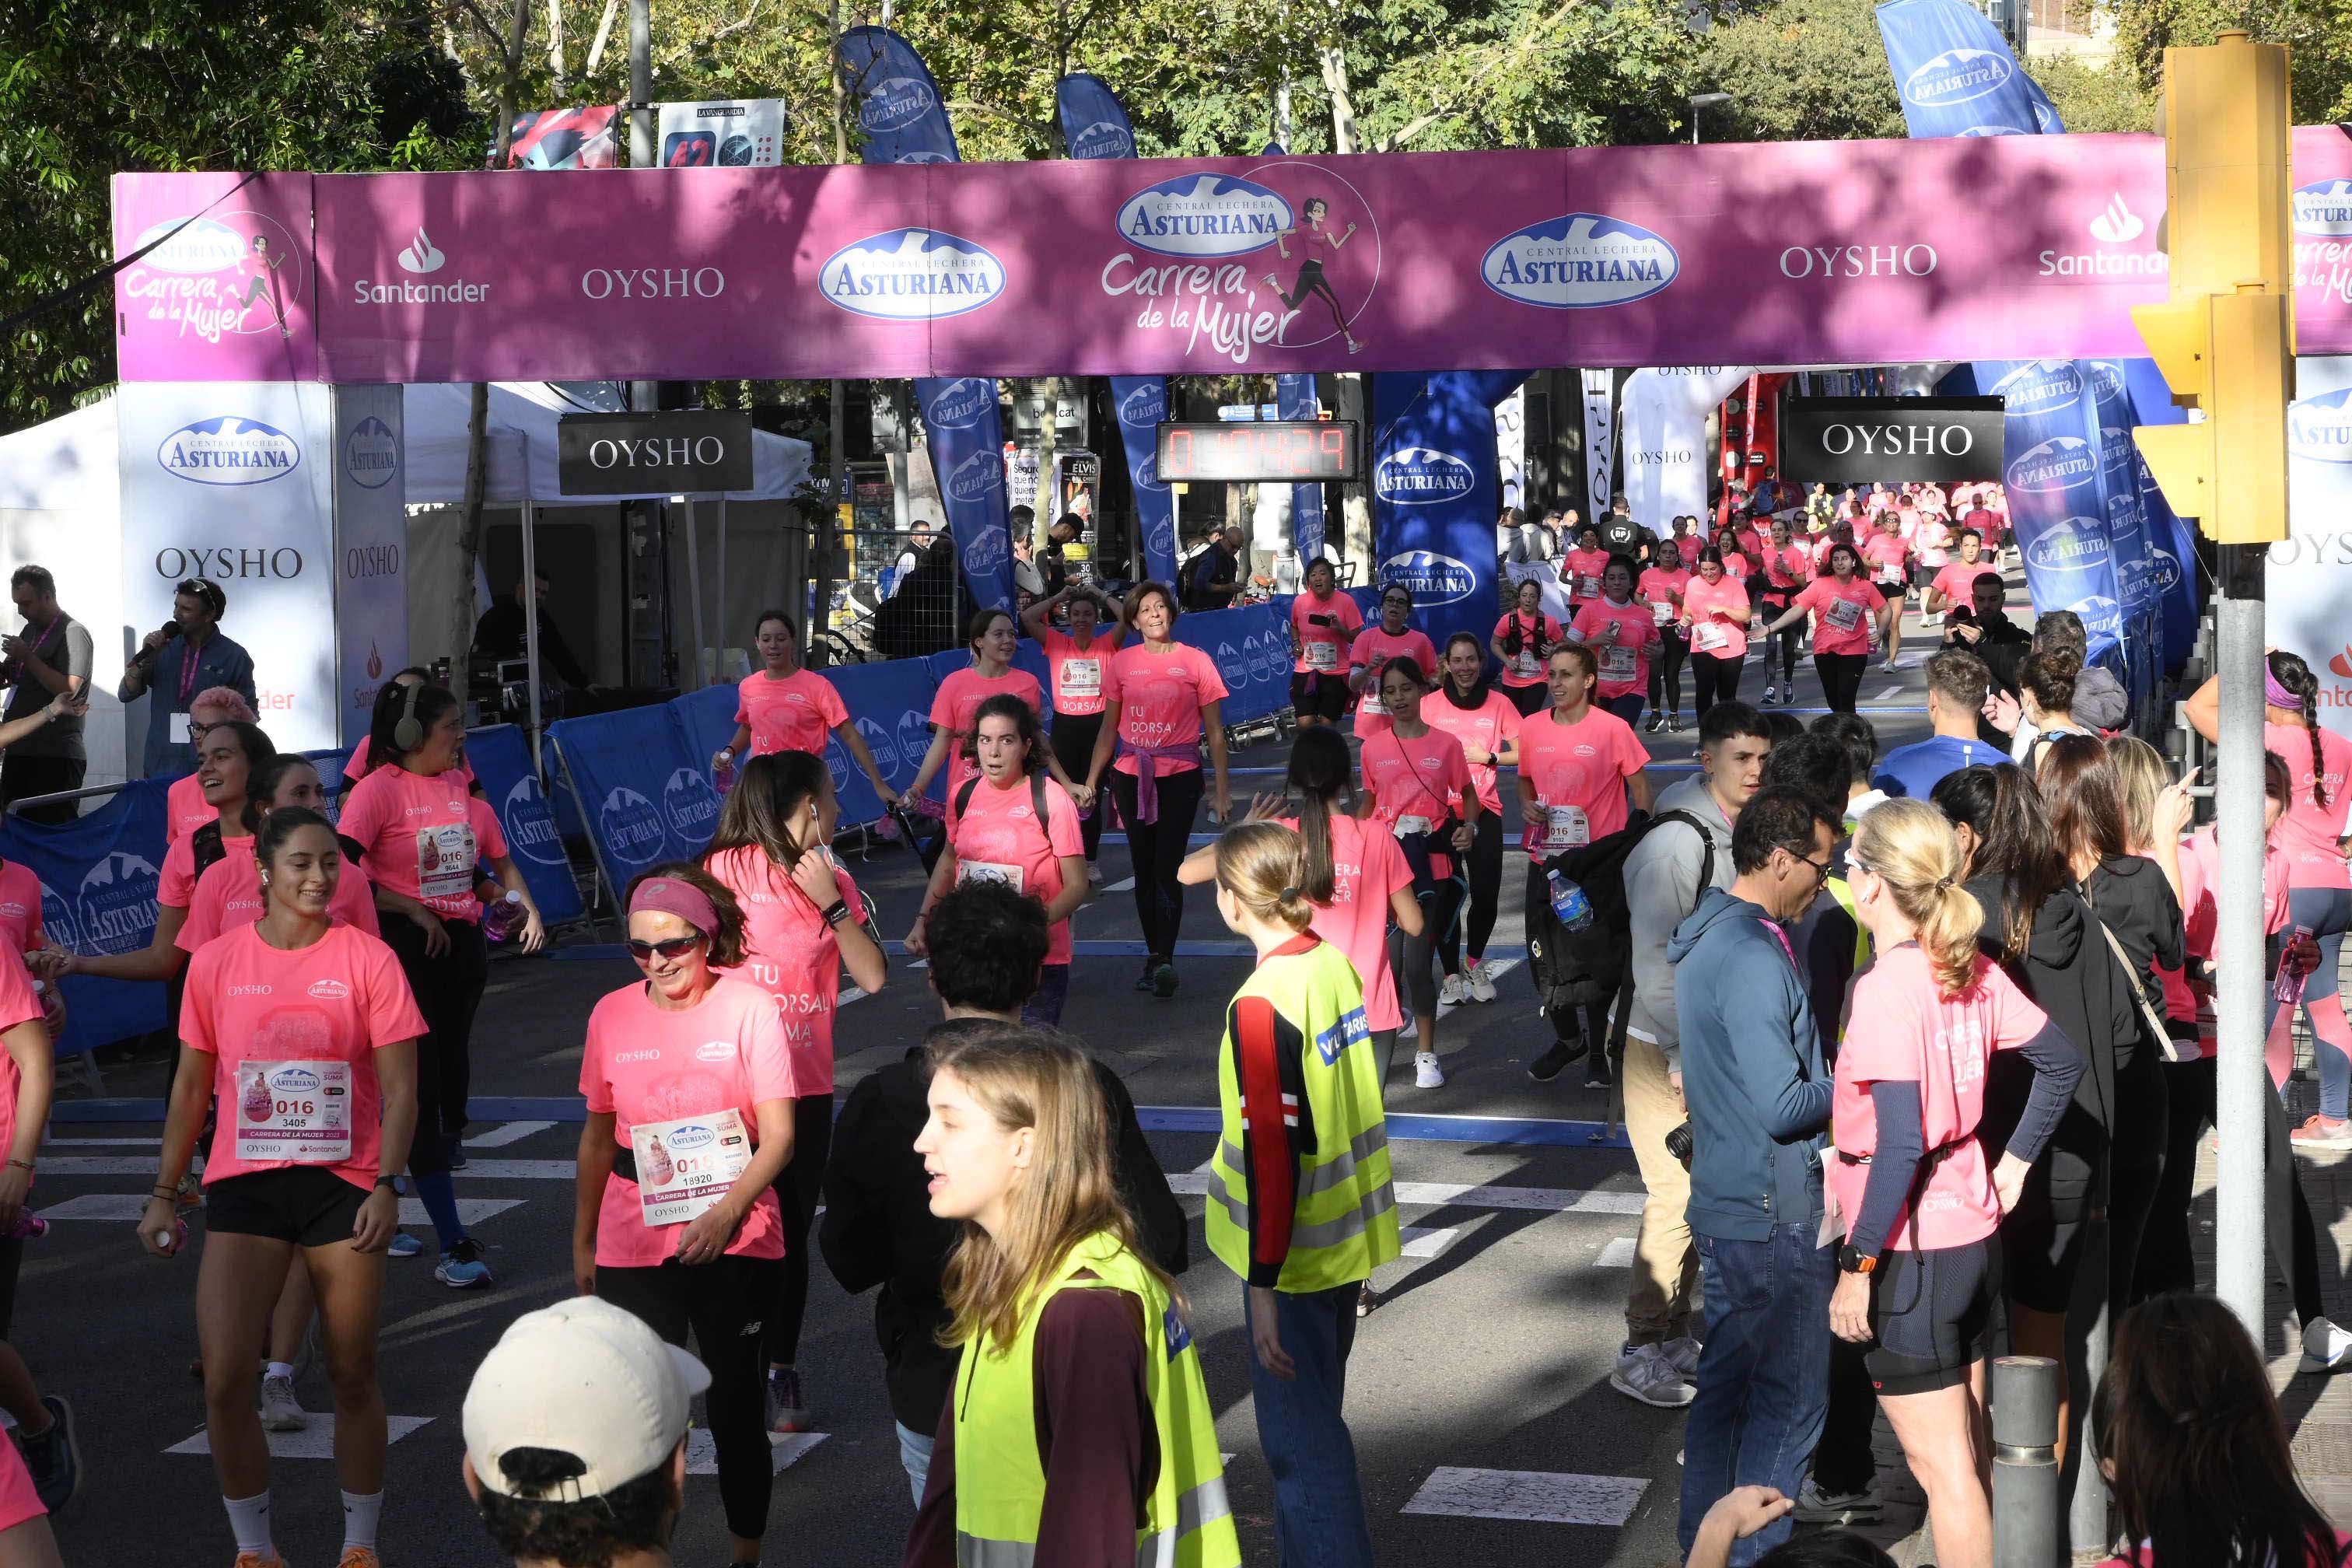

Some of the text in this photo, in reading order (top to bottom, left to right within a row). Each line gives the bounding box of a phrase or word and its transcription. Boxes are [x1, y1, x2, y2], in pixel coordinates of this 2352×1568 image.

[1157, 200, 1274, 212] CENTRAL LECHERA
[1130, 205, 1278, 236] ASTURIANA
[1527, 244, 1657, 257] CENTRAL LECHERA
[926, 257, 985, 268] LECHERA
[1496, 250, 1664, 286] ASTURIANA
[1780, 243, 1937, 279] OYSHO
[581, 266, 725, 299] OYSHO
[834, 262, 991, 297] ASTURIANA
[1101, 254, 1247, 296] Carrera
[2311, 264, 2325, 287] la
[124, 270, 216, 298] Carrera
[354, 278, 492, 305] Santander
[149, 294, 254, 344] de la Mujer
[1137, 290, 1301, 364] de la Mujer
[190, 438, 285, 448] CENTRAL LECHERA
[1822, 423, 1974, 457] OYSHO
[169, 441, 290, 469] ASTURIANA
[349, 443, 395, 471] ASTURIANA
[589, 436, 725, 470] OYSHO
[1632, 450, 1692, 465] OYSHO
[1073, 463, 1096, 474] ELVIS
[1014, 477, 1027, 485] que
[1380, 471, 1468, 492] ASTURIANA
[1615, 530, 1626, 538] BP
[155, 547, 303, 579] OYSHO
[347, 544, 400, 580] OYSHO
[1080, 564, 1090, 572] 30
[1130, 705, 1145, 719] TU
[1550, 827, 1569, 836] 016
[441, 851, 462, 863] 016
[751, 964, 779, 985] TU
[226, 984, 273, 996] OYSHO
[311, 986, 347, 996] ASTURIANA
[771, 992, 829, 1013] ORSAL
[785, 1020, 812, 1041] MA
[615, 1048, 660, 1064] OYSHO
[275, 1076, 317, 1087] ASTURIANA
[276, 1100, 314, 1115] 016
[282, 1118, 306, 1128] 3405
[716, 1123, 738, 1132] SUMA
[671, 1134, 712, 1146] ASTURIANA
[247, 1144, 281, 1153] OYSHO
[683, 1174, 712, 1186] 18920
[655, 1192, 687, 1201] CARRERA
[697, 1187, 707, 1195] LA
[707, 1184, 730, 1194] MUJER
[654, 1206, 689, 1217] OYSHO
